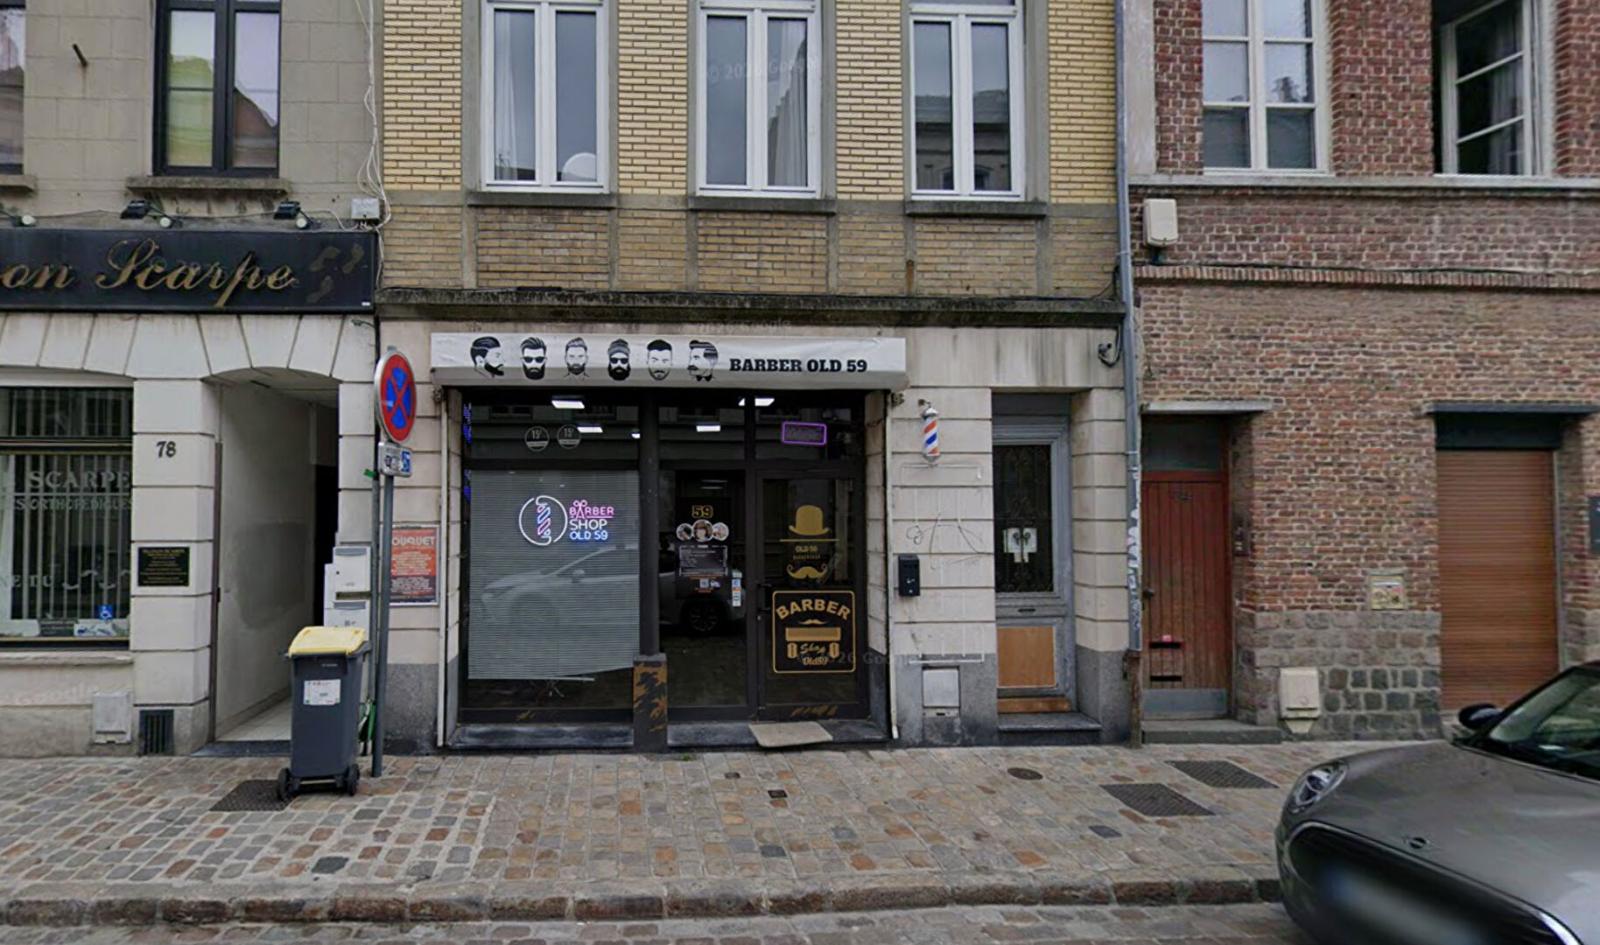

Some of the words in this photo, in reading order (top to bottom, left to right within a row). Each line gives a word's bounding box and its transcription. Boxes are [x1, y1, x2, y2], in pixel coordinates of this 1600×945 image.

[96, 238, 300, 309] Scarpe
[729, 358, 802, 373] BARBER
[807, 359, 842, 373] OLD
[847, 359, 868, 373] 59
[156, 440, 176, 457] 78
[29, 470, 130, 489] SCARPE
[569, 500, 615, 519] BARBER
[692, 505, 713, 518] 59
[569, 519, 608, 531] SHOP
[390, 535, 435, 547] OUQUET
[569, 530, 592, 541] OLD
[594, 530, 608, 541] 59
[776, 598, 851, 620] BARBER
